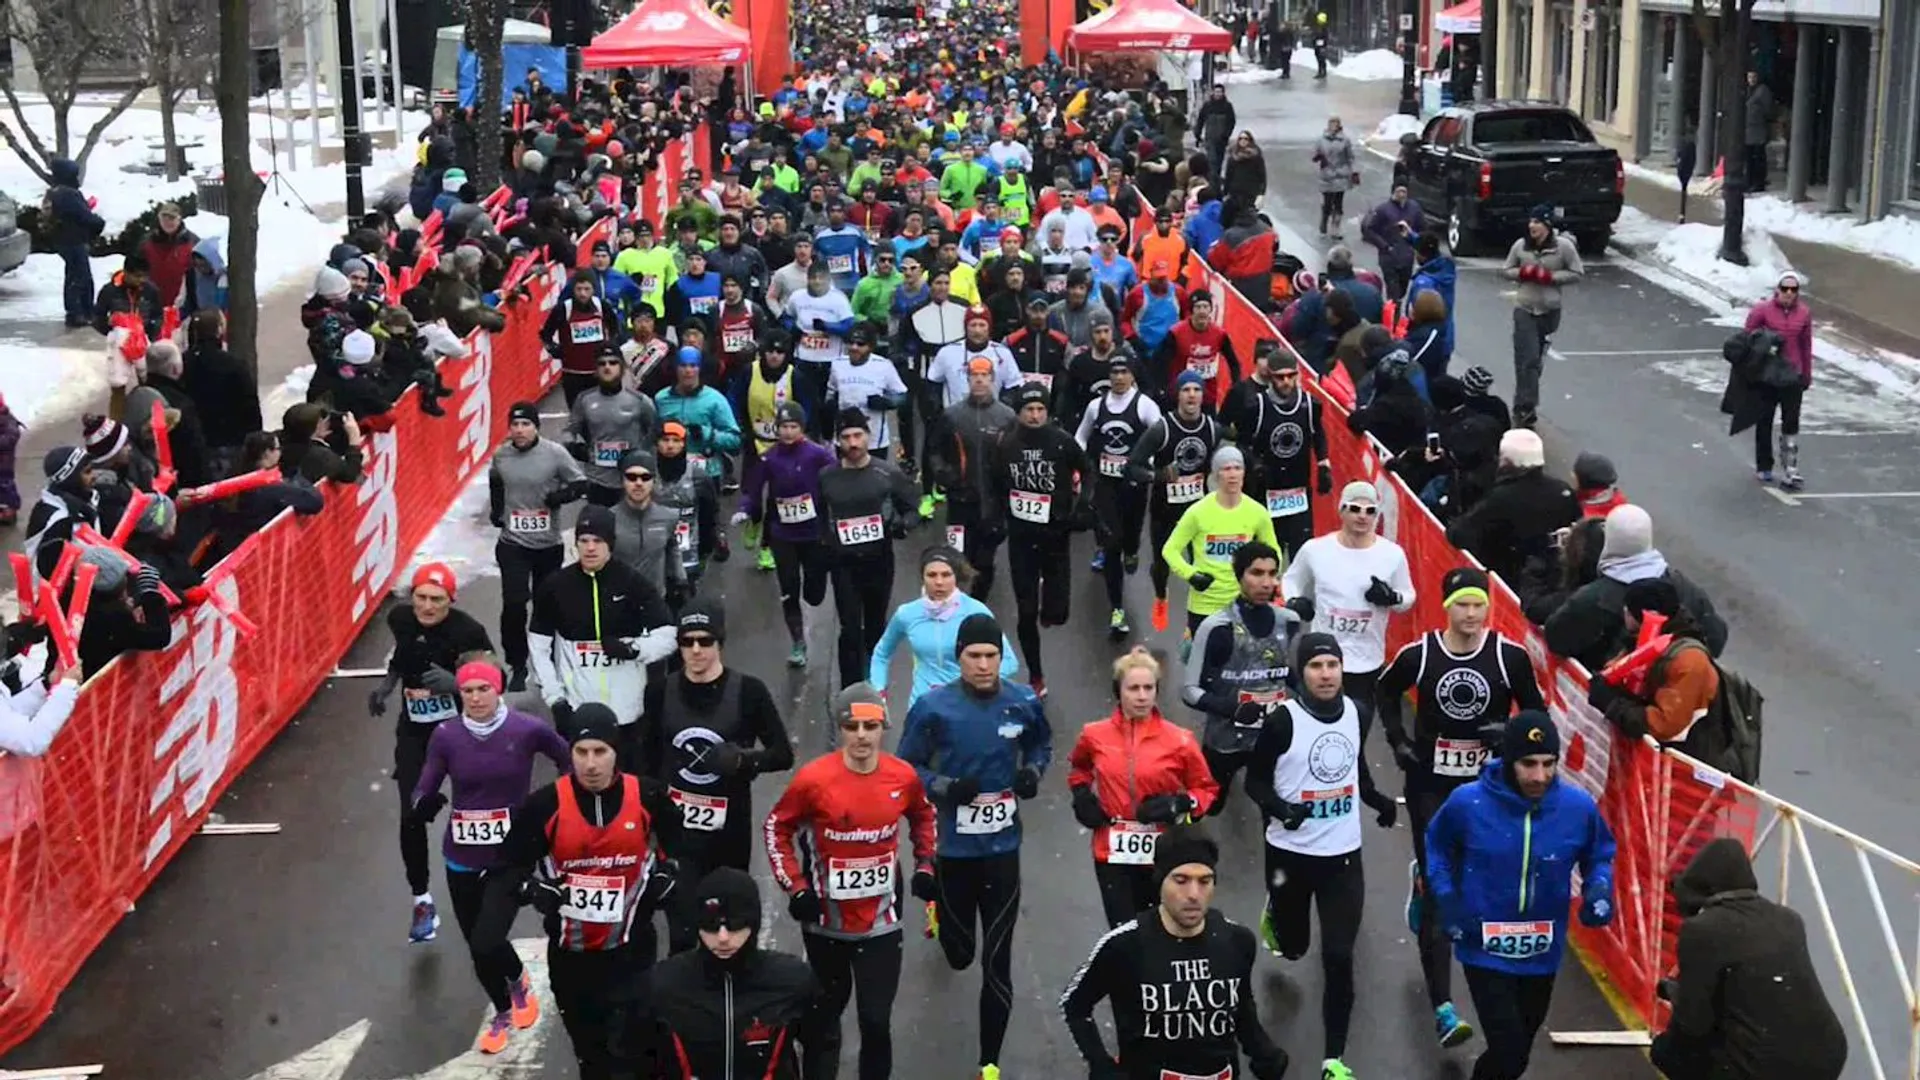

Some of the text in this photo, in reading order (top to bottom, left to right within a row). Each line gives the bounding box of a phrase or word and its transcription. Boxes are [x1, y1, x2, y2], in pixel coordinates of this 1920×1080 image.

[598, 449, 620, 461] 220
[1022, 449, 1044, 461] THE
[1009, 461, 1055, 477] BACK
[784, 503, 809, 517] 178
[1015, 499, 1043, 515] 312
[1270, 495, 1305, 511] 2280
[514, 516, 547, 530] 1633
[843, 523, 880, 542] 1649
[1328, 615, 1370, 634] 1327
[580, 652, 621, 667] 173
[1441, 670, 1486, 698] BLACK LUNGS
[410, 694, 452, 715] 2036
[1313, 737, 1332, 763] BLACK
[1440, 748, 1489, 767] 1192
[969, 802, 1007, 824] 793
[456, 820, 505, 842] 1434
[824, 828, 880, 843] running
[562, 855, 614, 869] running
[836, 866, 890, 890] 1239
[561, 886, 620, 911] 1347
[1487, 934, 1549, 955] 2356
[1171, 959, 1211, 982] THE
[1140, 978, 1242, 1012] BLACK
